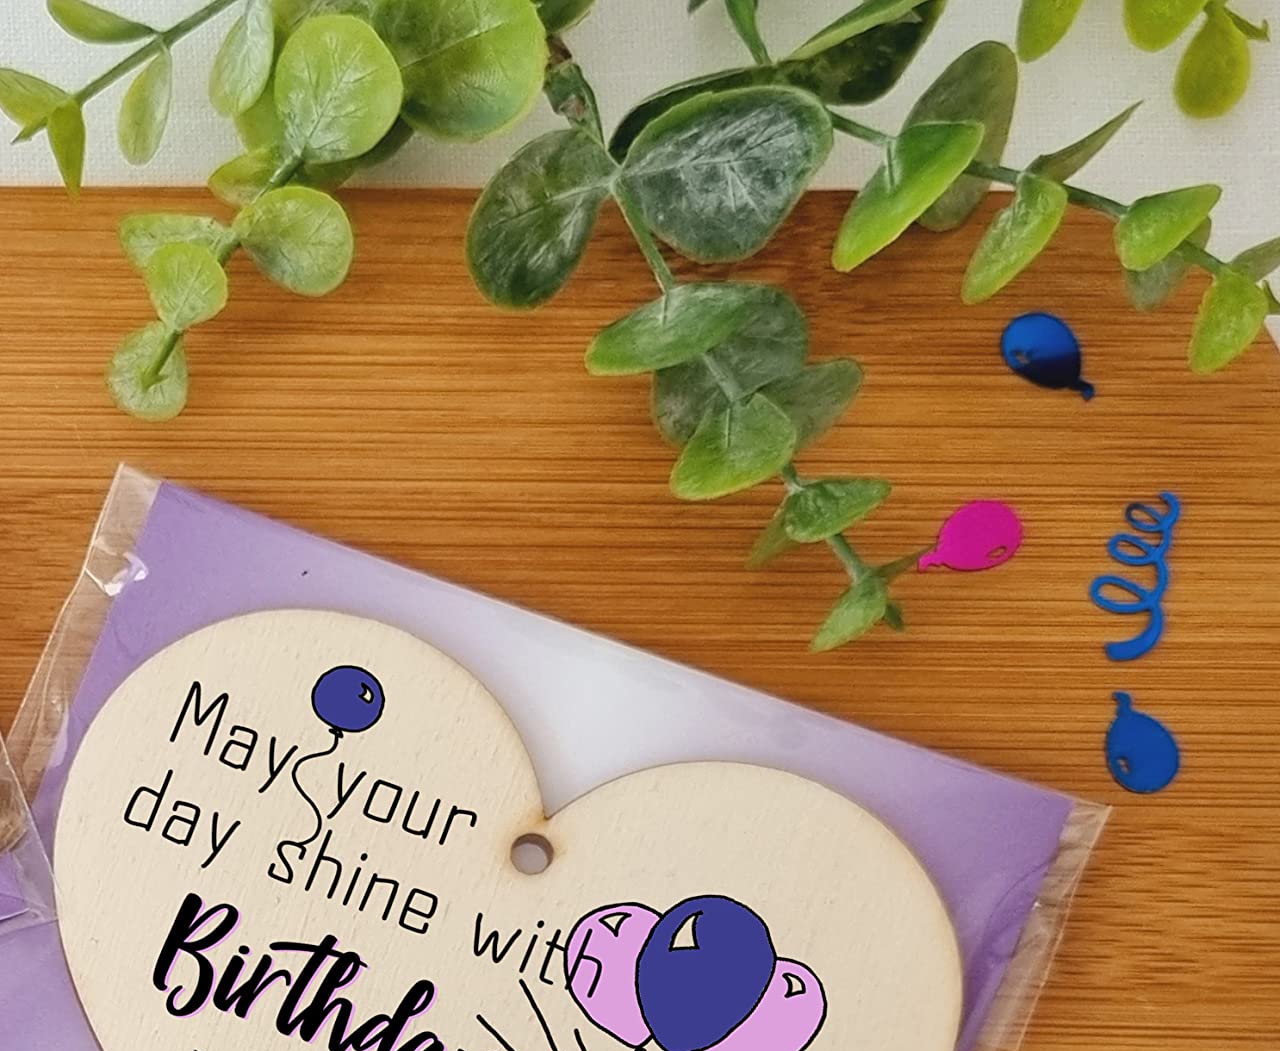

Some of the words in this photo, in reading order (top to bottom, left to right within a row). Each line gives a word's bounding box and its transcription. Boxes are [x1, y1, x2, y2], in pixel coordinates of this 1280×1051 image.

[169, 681, 298, 794] May
[328, 761, 477, 845] your
[123, 770, 240, 868] day
[268, 829, 438, 935] shine
[472, 912, 603, 998] with
